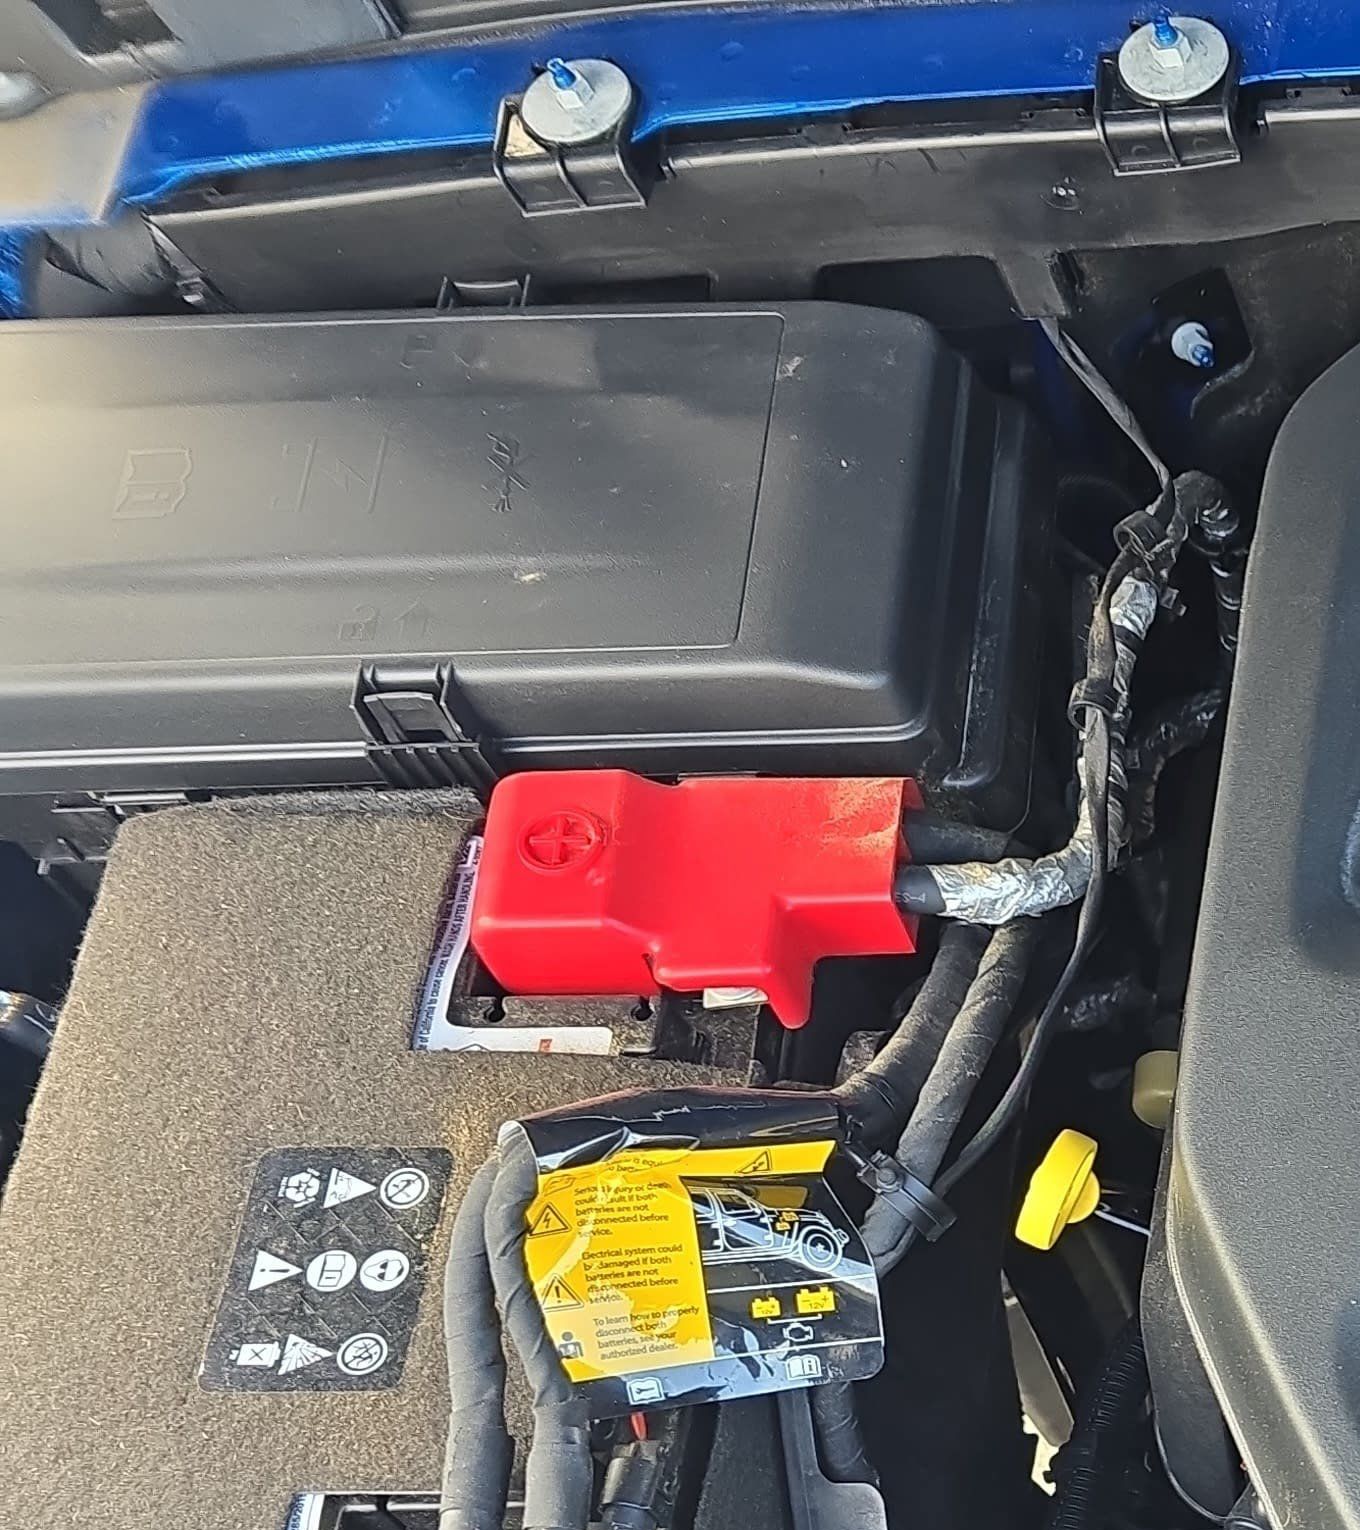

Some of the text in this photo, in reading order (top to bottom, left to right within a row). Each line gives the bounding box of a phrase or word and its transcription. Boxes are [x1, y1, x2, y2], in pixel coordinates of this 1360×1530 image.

[582, 1244, 683, 1260] Electrical system could
[650, 1256, 672, 1264] both
[650, 1278, 679, 1286] before
[605, 1316, 628, 1324] learn
[630, 1313, 650, 1321] how
[663, 1306, 699, 1318] properly
[596, 1324, 643, 1338] disconnect
[656, 1332, 677, 1341] your
[601, 1342, 678, 1360] authorized dealer.
